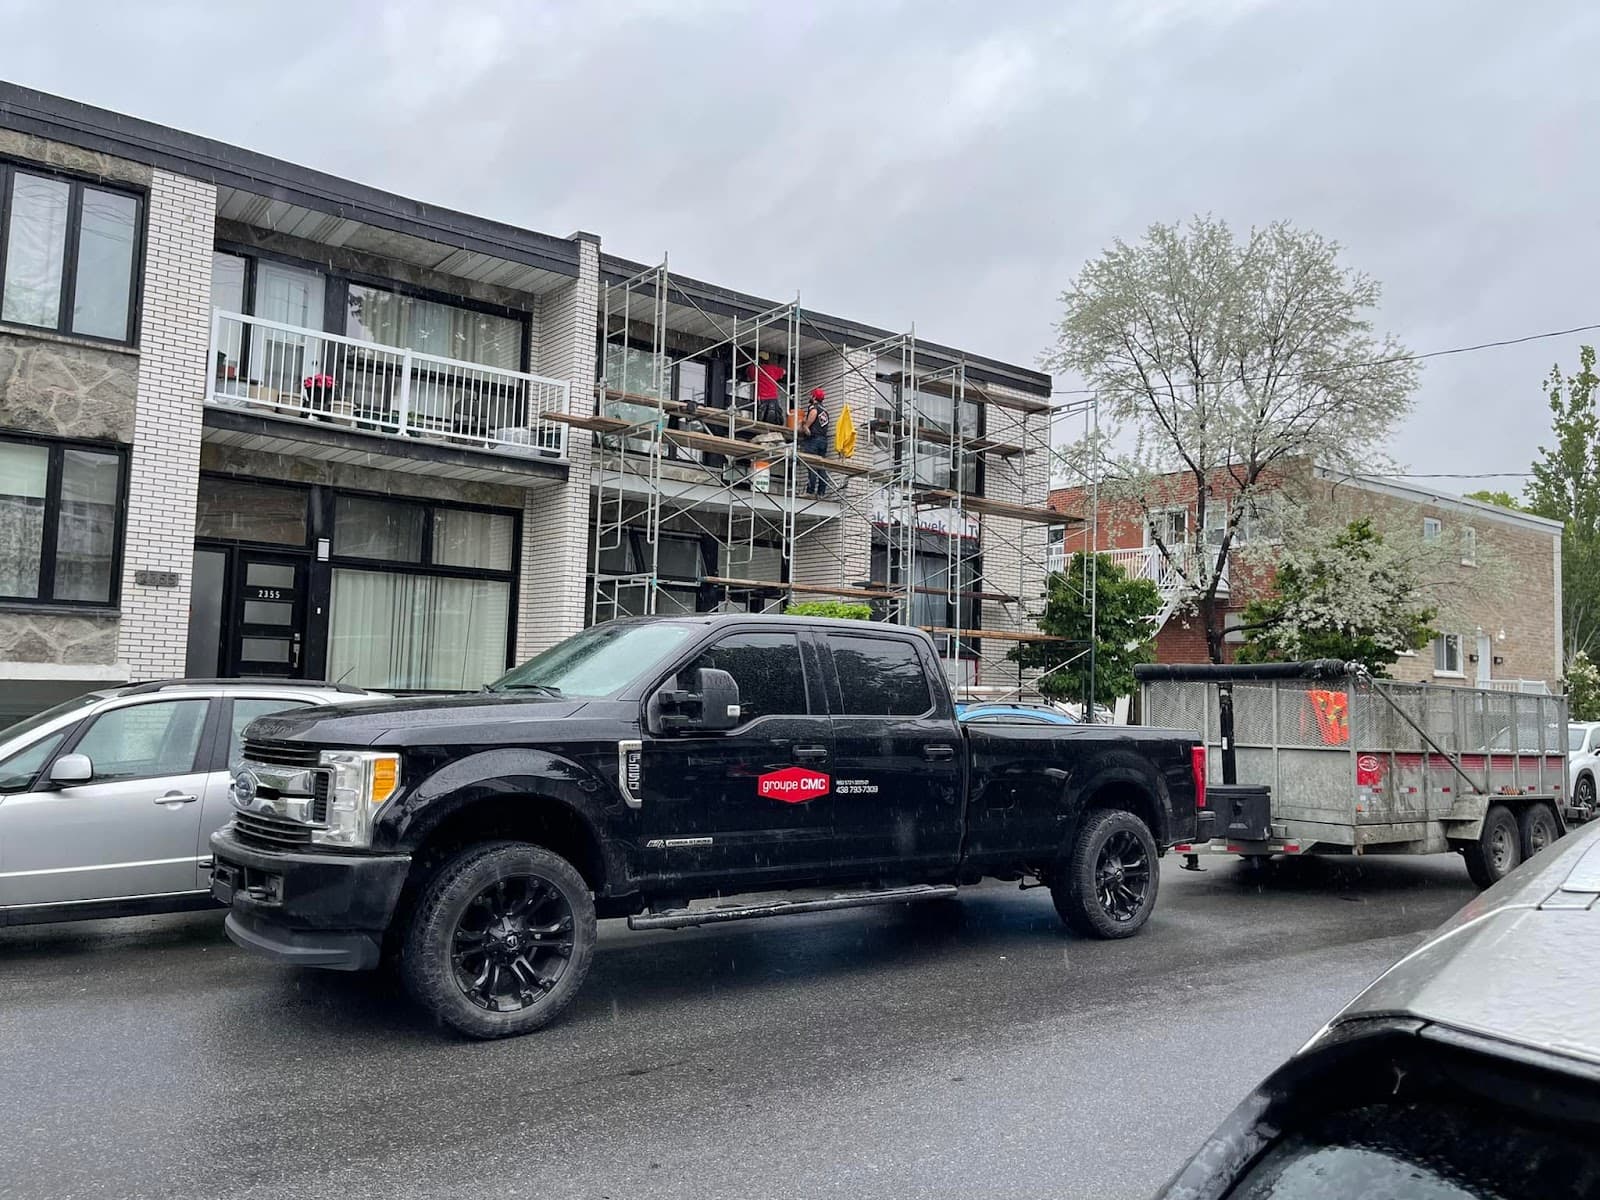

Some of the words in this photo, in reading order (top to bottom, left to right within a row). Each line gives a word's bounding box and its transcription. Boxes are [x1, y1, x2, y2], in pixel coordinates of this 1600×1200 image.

[258, 590, 280, 599] 2355
[762, 780, 799, 793] groupe
[800, 778, 826, 790] CMC
[836, 785, 849, 794] 438
